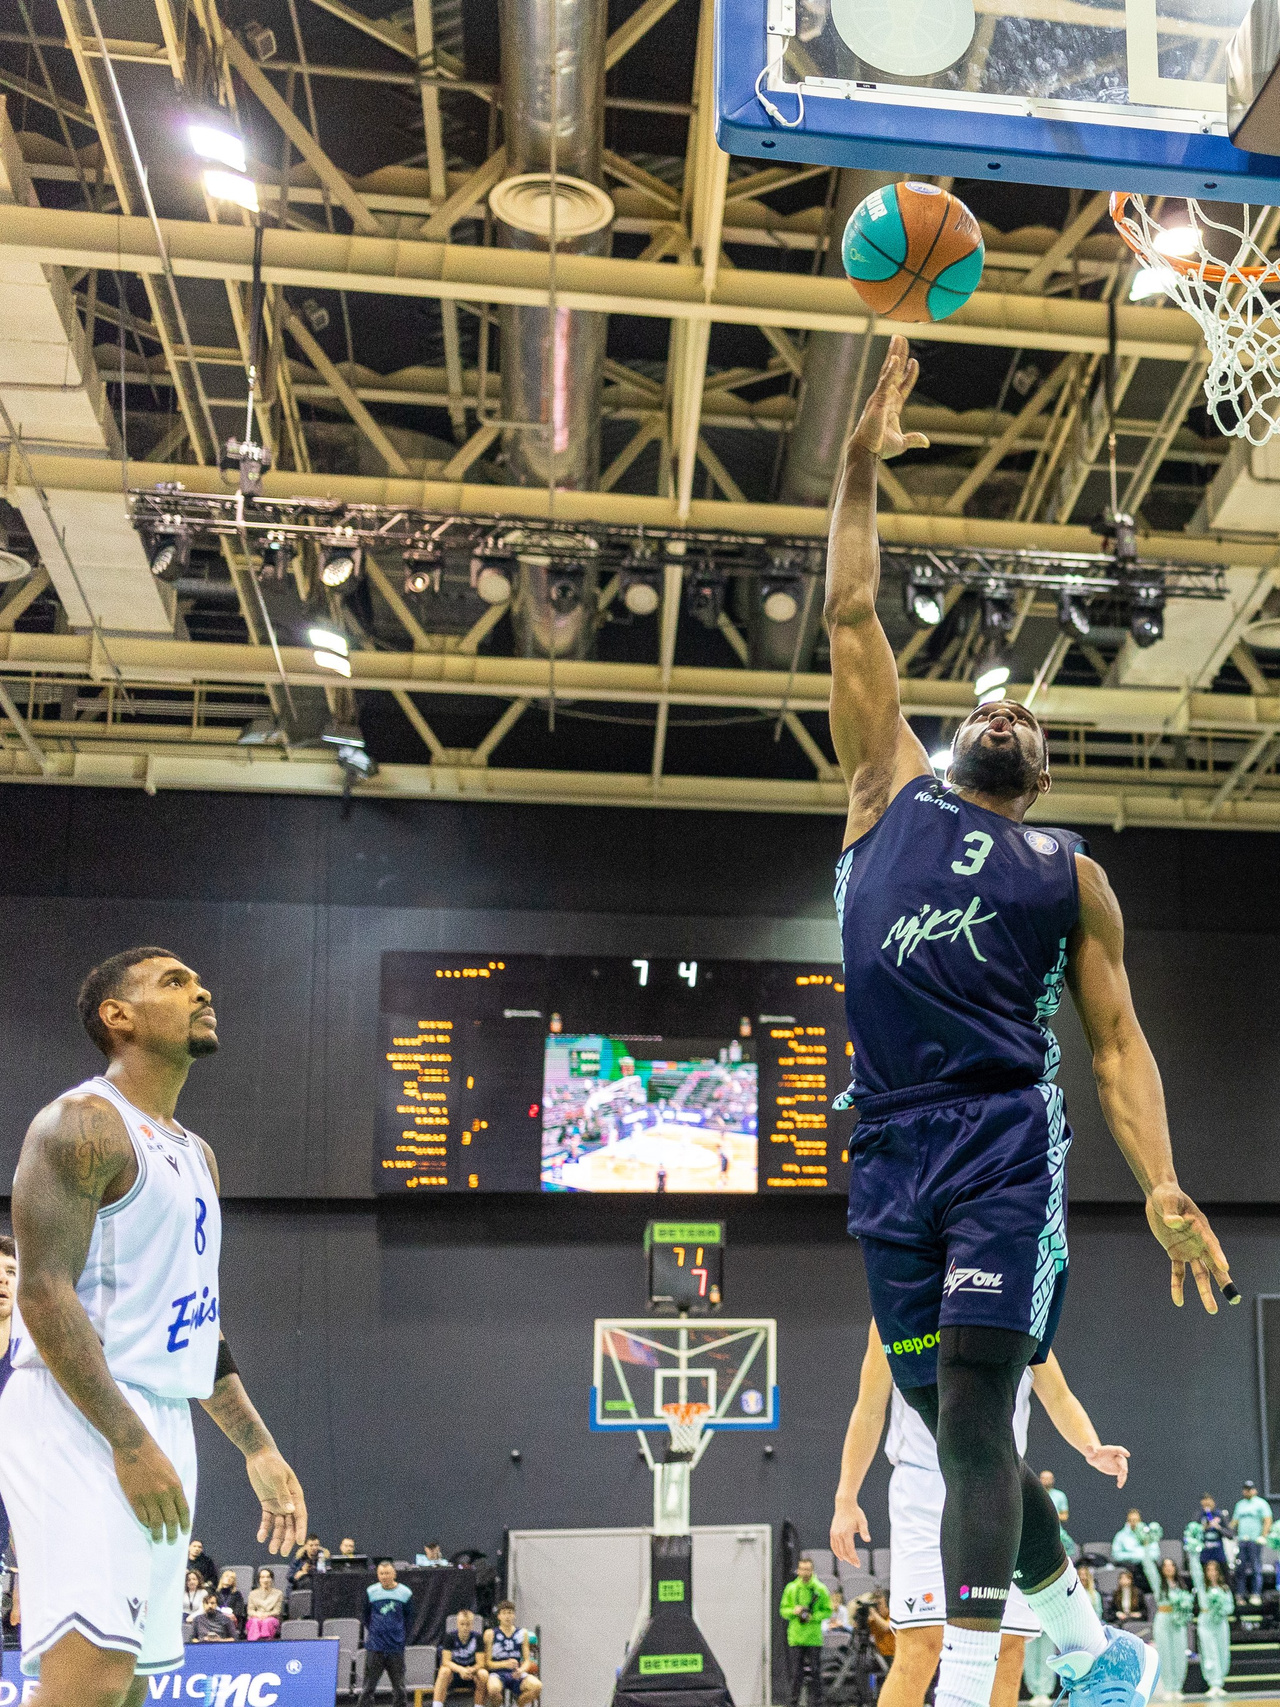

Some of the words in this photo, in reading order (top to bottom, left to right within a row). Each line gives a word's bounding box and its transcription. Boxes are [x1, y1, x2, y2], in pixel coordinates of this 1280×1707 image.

[951, 830, 994, 876] 3
[632, 960, 649, 986] 7
[678, 961, 698, 988] 4
[195, 1197, 207, 1256] 8
[691, 1268, 708, 1297] 7
